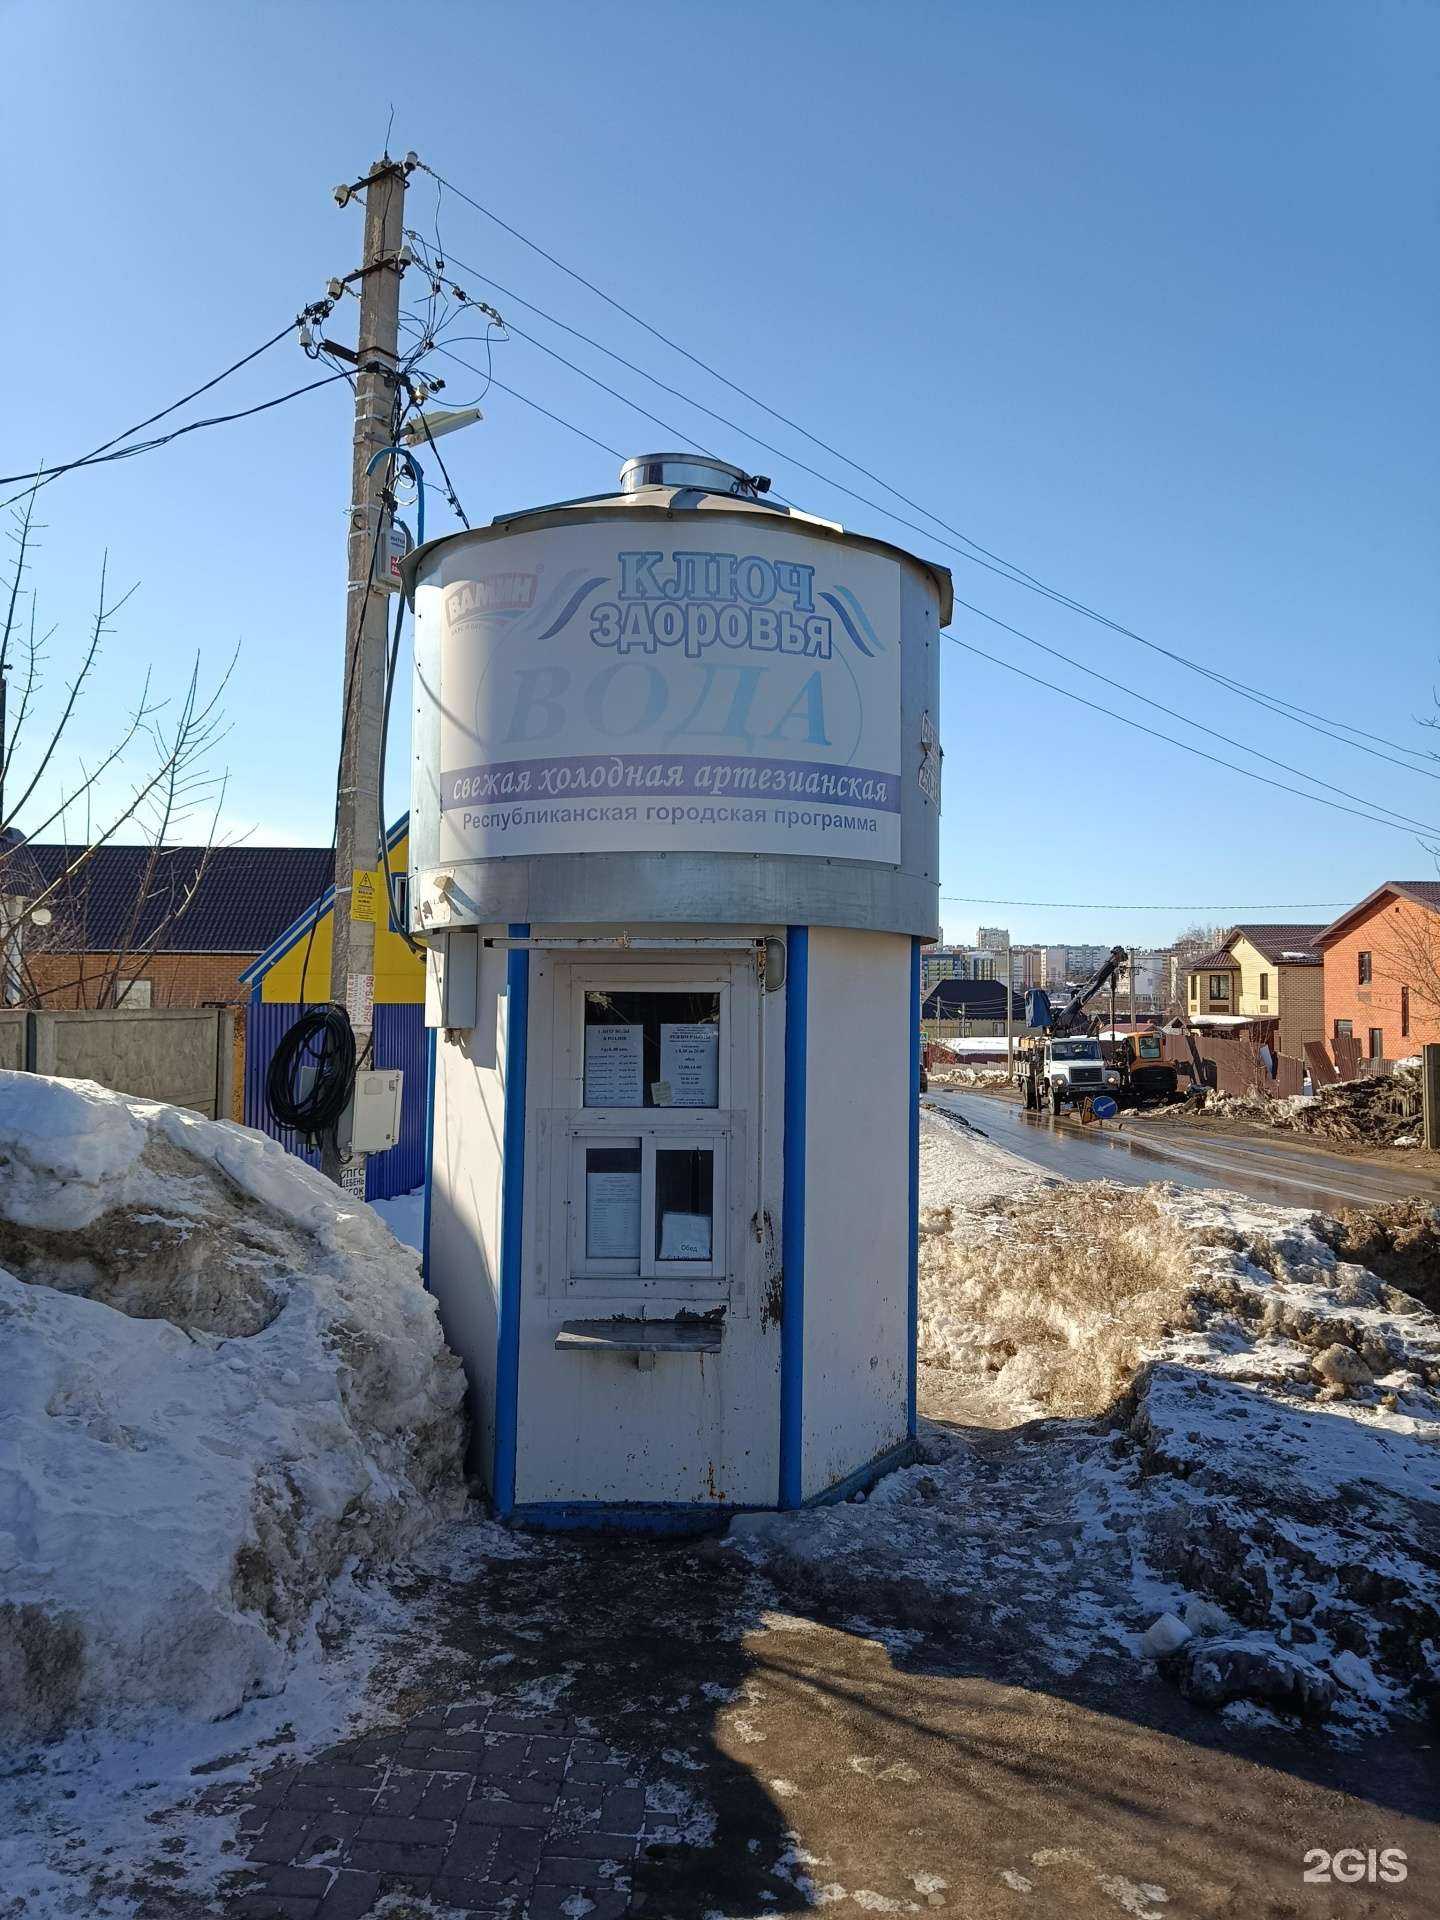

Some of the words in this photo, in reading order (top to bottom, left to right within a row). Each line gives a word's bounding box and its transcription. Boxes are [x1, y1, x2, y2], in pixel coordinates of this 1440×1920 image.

[617, 551, 815, 613] КЛЮЧ
[501, 662, 832, 752] ВОДА
[453, 769, 532, 800] свежая
[538, 756, 684, 795] холодная
[694, 763, 887, 802] артезианская
[463, 806, 637, 831] Республиканская
[646, 807, 766, 825] городская
[774, 808, 877, 832] программа
